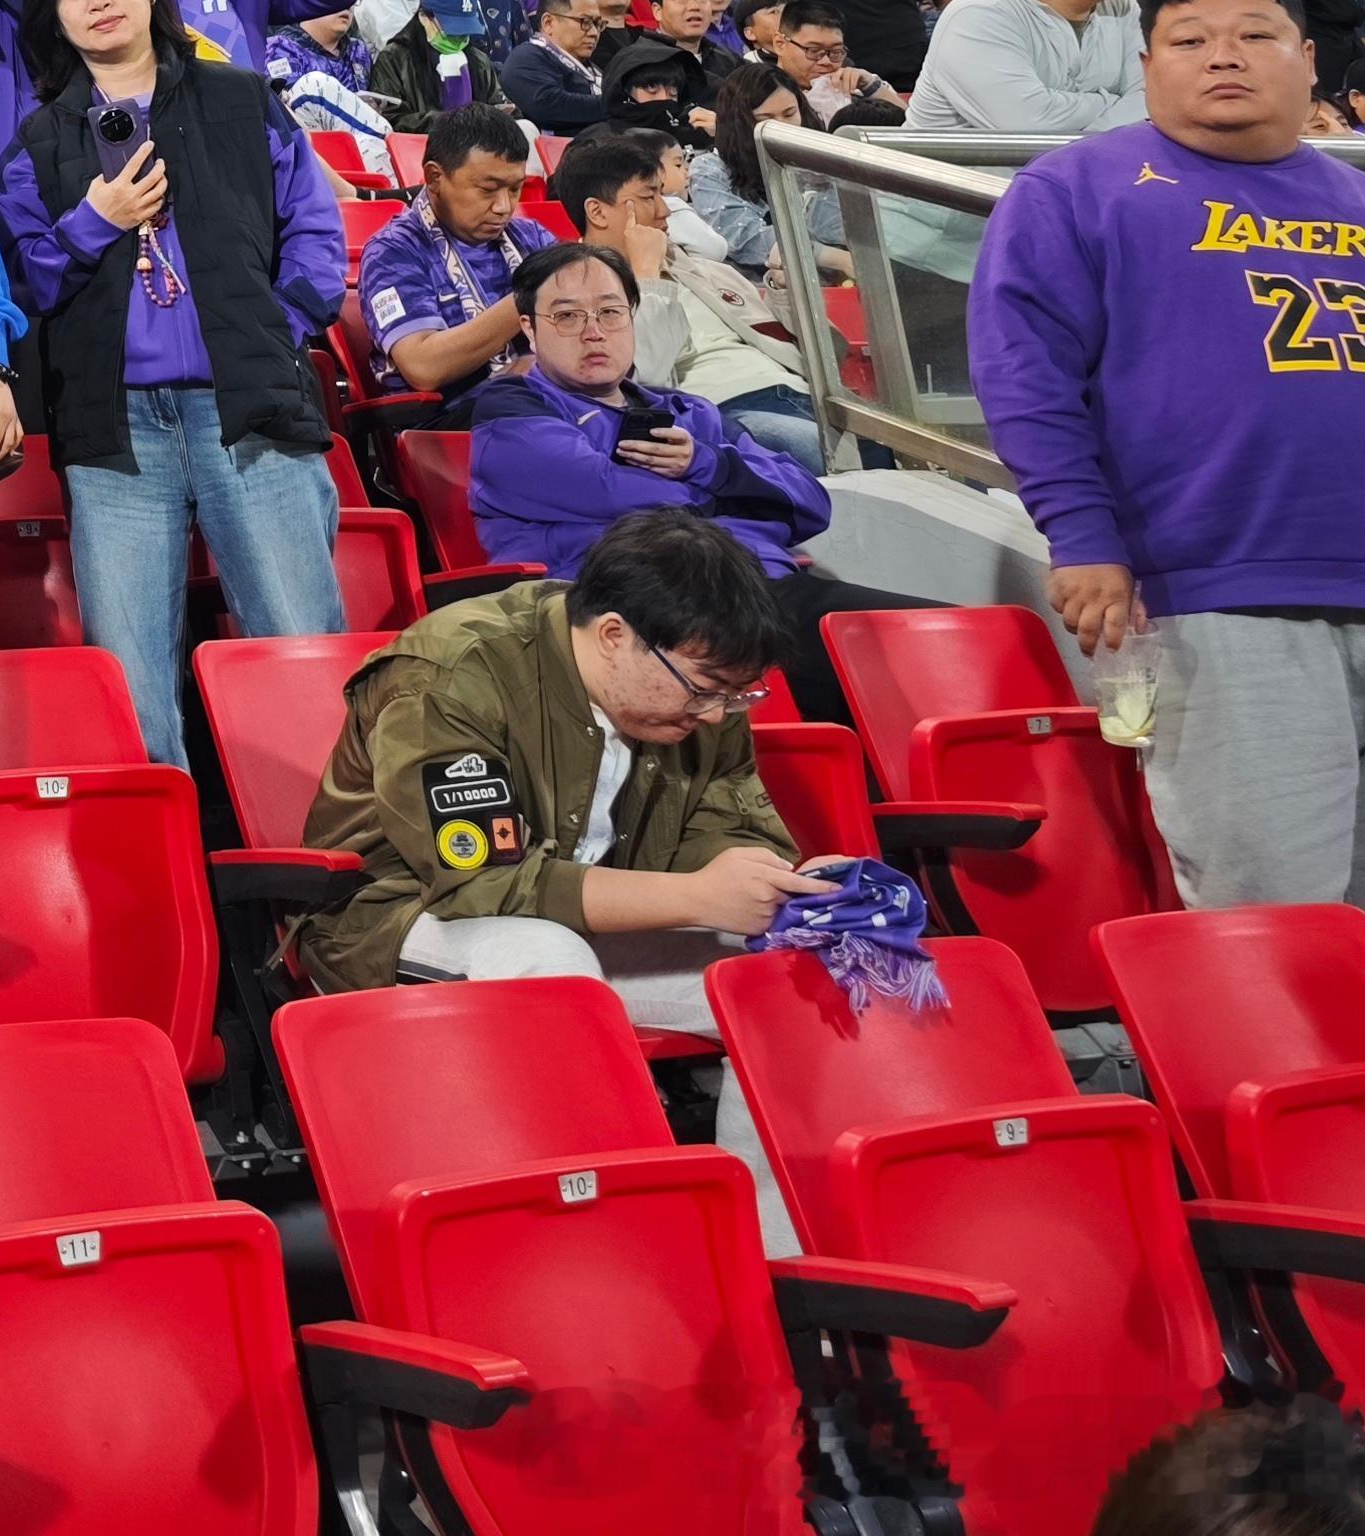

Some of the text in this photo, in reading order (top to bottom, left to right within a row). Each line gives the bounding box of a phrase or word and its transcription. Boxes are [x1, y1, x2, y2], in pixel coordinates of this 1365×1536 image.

[1190, 200, 1365, 258] LAKER
[44, 780, 60, 795] 10
[443, 787, 498, 804] 1/10000
[1005, 1122, 1016, 1142] 9
[568, 1176, 588, 1198] 10
[69, 1237, 89, 1260] 11
